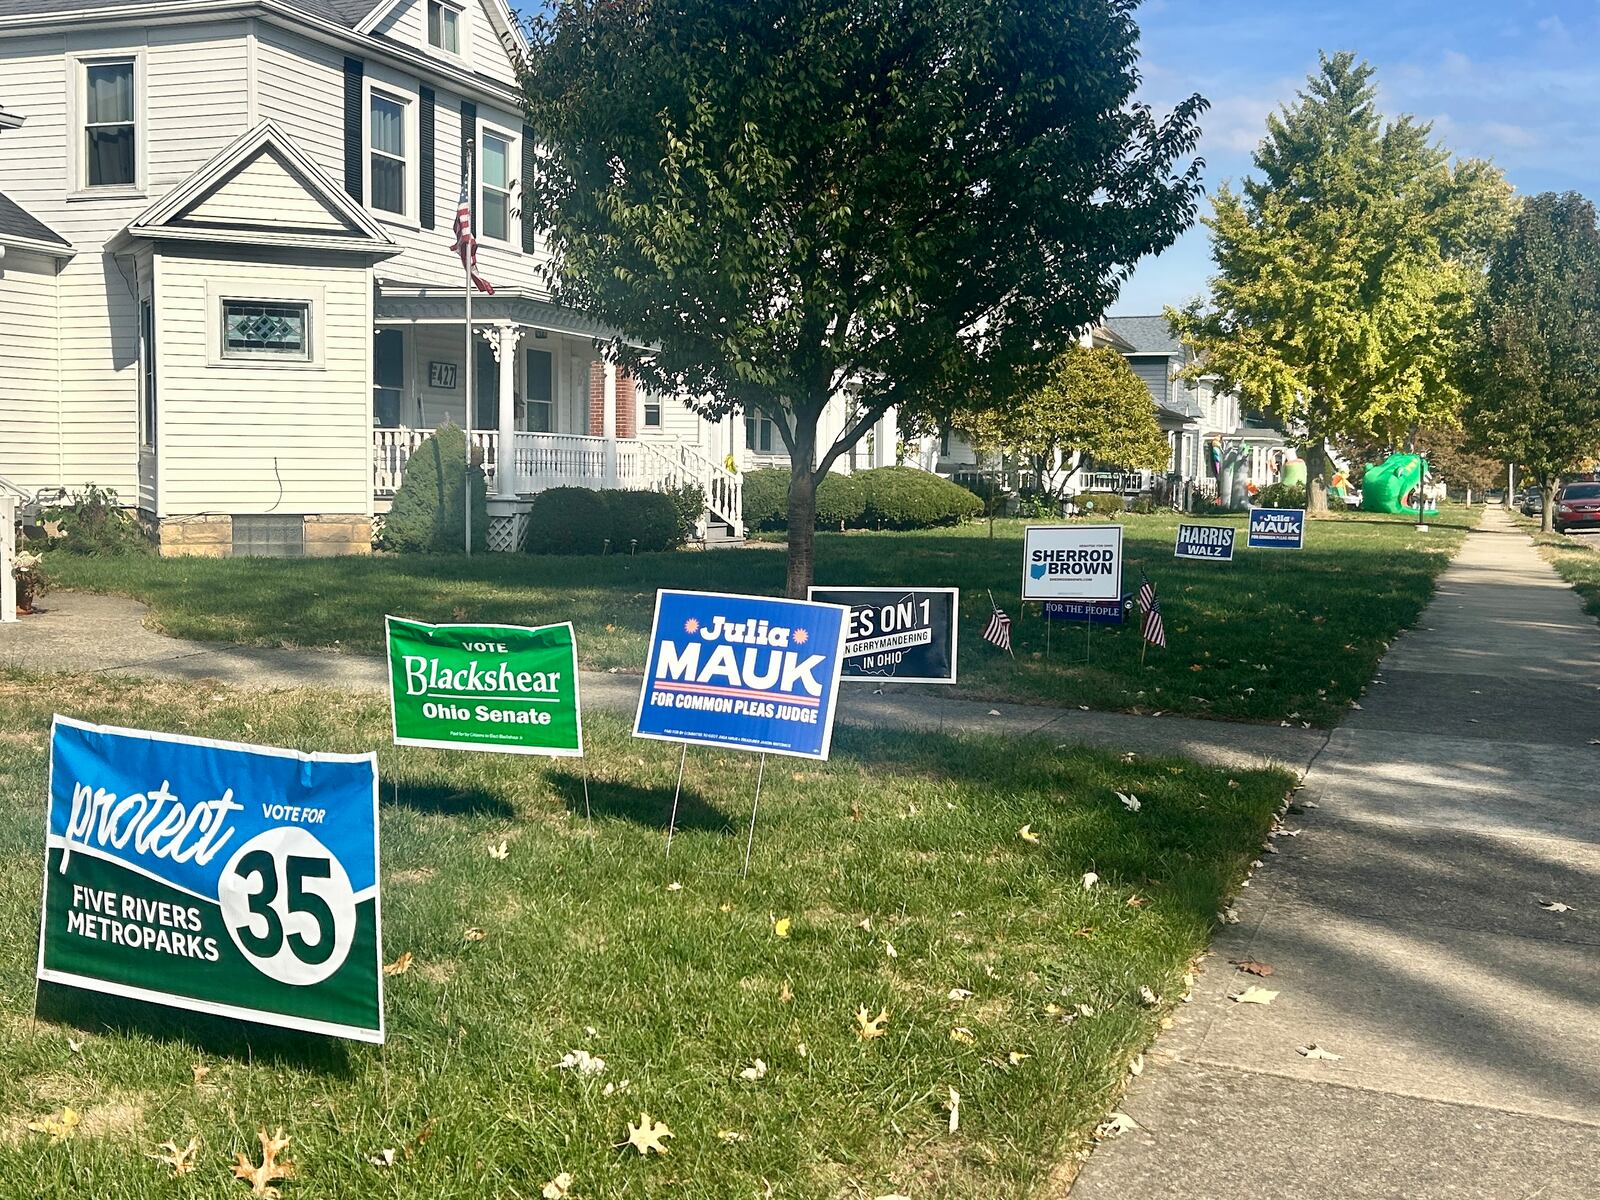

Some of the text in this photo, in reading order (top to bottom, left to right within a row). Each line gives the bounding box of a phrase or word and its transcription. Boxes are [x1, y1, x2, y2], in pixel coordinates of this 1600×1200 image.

[437, 365, 454, 385] 427
[1251, 521, 1300, 533] MAUK
[1264, 514, 1290, 522] Julia
[1180, 526, 1232, 546] HARRIS
[1032, 550, 1114, 562] SHERROD
[1187, 545, 1222, 556] WALZ
[1048, 562, 1113, 575] BROWN
[847, 598, 930, 639] ES ON 1
[1045, 602, 1120, 617] FOR THE PEOPLE
[700, 615, 791, 647] Julia
[853, 631, 928, 653] GERRYMANDERING
[462, 642, 509, 653] VOTE
[655, 640, 827, 697] MAUK
[863, 651, 902, 669] IN OHIO
[402, 655, 561, 696] Blackshear
[422, 702, 552, 725] Ohio Senate
[650, 691, 819, 725] FOR COMMON PLEAS JUDGE
[262, 803, 326, 825] VOTE FOR
[59, 779, 245, 875] protect
[73, 884, 202, 932] FIVE RIVERS
[233, 849, 336, 966] 35
[67, 909, 220, 962] METROPARKS
